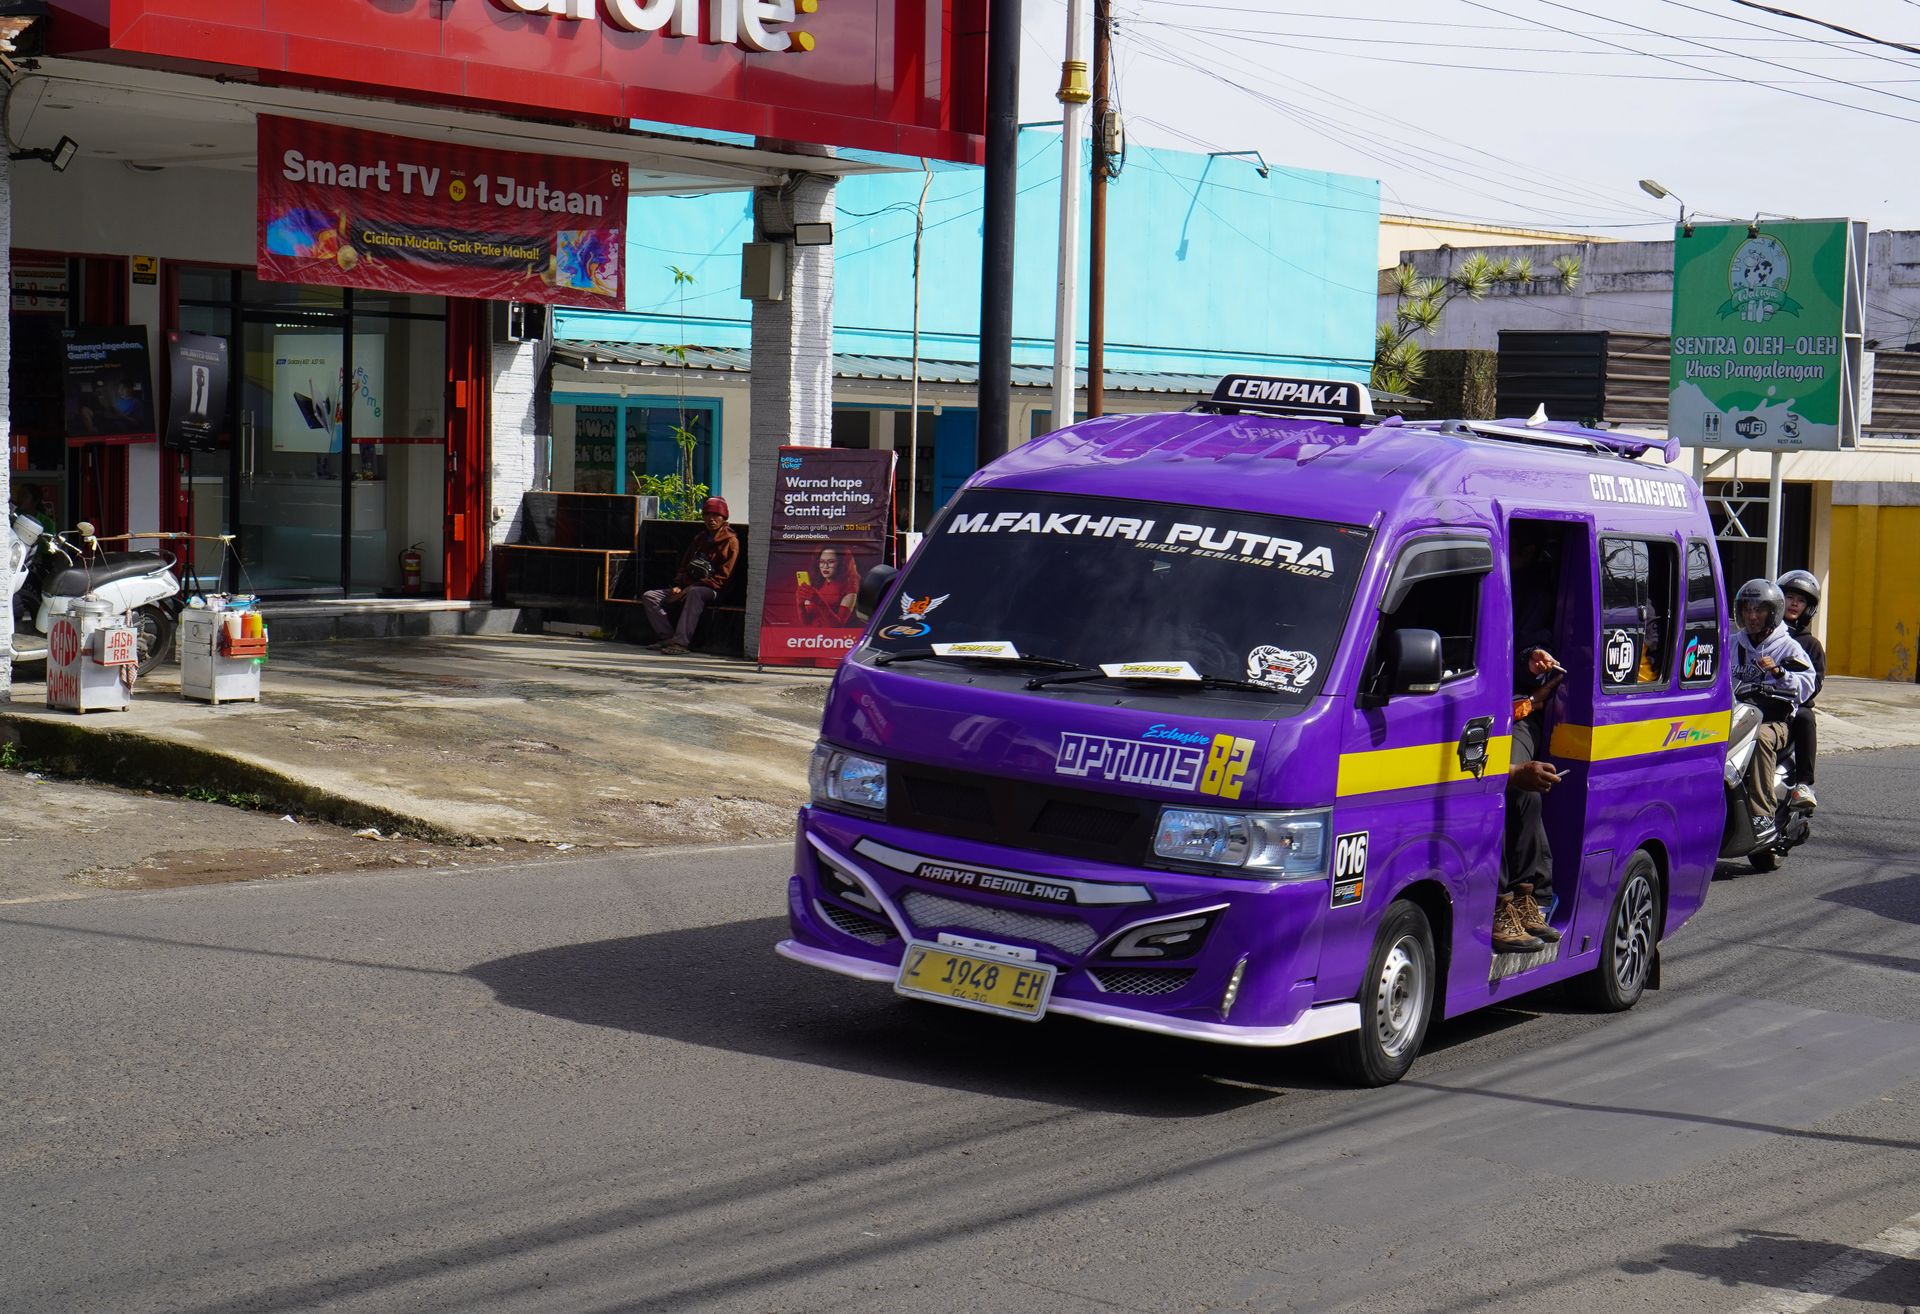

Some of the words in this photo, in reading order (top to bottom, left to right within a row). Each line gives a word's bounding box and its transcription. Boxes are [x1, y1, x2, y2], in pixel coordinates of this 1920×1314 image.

[283, 150, 390, 192] Smart
[397, 163, 440, 197] TV
[453, 186, 463, 195] Rp
[473, 174, 488, 203] 1
[363, 231, 402, 246] Cicilan
[404, 234, 447, 253] Mudah,
[449, 239, 473, 252] Gak
[474, 243, 501, 256] Pake
[503, 246, 540, 260] Mahal!
[1674, 336, 1737, 355] SENTRA
[1685, 360, 1721, 379] Khas
[1724, 359, 1824, 382] Pangalengan
[1227, 379, 1348, 406] CEMPAKA
[785, 477, 829, 488] Warna
[831, 477, 863, 490] hape
[784, 492, 809, 504] gak
[810, 491, 874, 505] matching,
[784, 505, 820, 516] Ganti
[821, 505, 846, 519] aja!
[810, 524, 828, 532] gratis
[947, 512, 1156, 541] M.FAKHRI
[1164, 523, 1335, 573] PUTRA
[1277, 562, 1334, 579] TRANS
[787, 635, 855, 649] erafone
[1277, 684, 1303, 694] GARUT
[1055, 732, 1204, 791] OPTIMIS
[1200, 733, 1256, 800] 82
[1336, 835, 1367, 877] 016
[919, 865, 976, 885] KARYA
[979, 875, 1070, 901] GEMILANG
[941, 957, 999, 991] 1948
[1013, 971, 1045, 1001] EH
